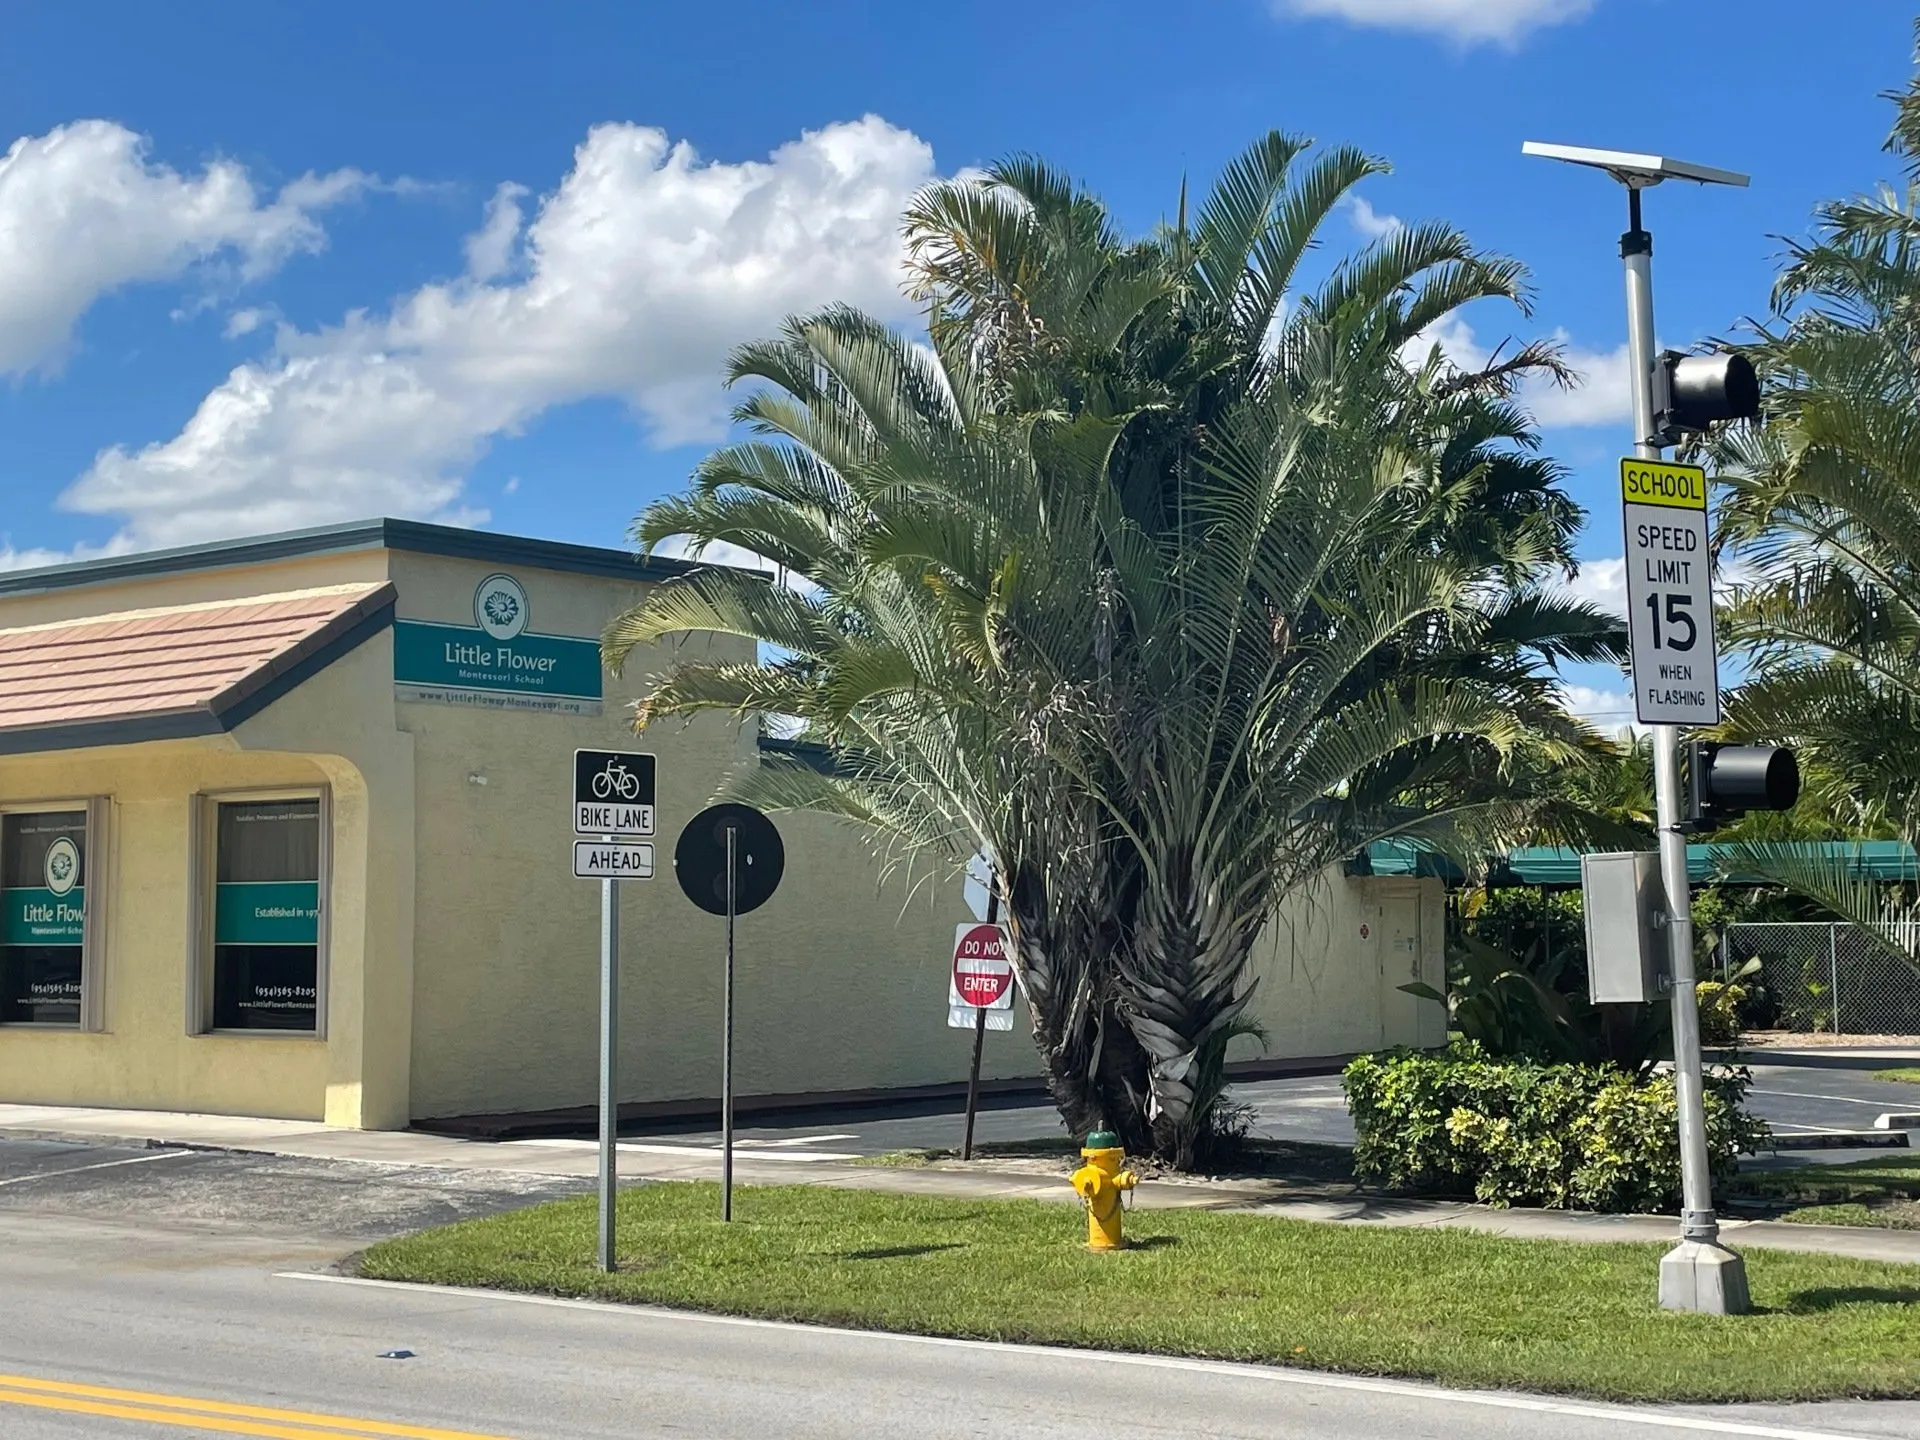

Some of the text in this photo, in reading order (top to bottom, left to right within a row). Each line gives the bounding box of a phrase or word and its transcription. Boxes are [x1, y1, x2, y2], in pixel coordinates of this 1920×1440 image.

[1628, 469, 1701, 500] SCHOOL
[1637, 524, 1697, 552] SPEED
[1645, 558, 1691, 585] LIMIT
[1646, 592, 1697, 652] 15
[445, 642, 556, 672] Little Flower
[459, 669, 544, 686] Montessori School
[1658, 664, 1692, 681] WHEN
[1648, 688, 1706, 706] FLASHING
[581, 807, 650, 829] BIKE LANE
[588, 850, 641, 870] AHEAD
[23, 903, 54, 923] Little
[254, 907, 296, 918] Established
[296, 907, 304, 917] in
[965, 940, 1003, 956] DO NO
[255, 985, 316, 998] (954)565-8205
[964, 976, 999, 993] ENTER
